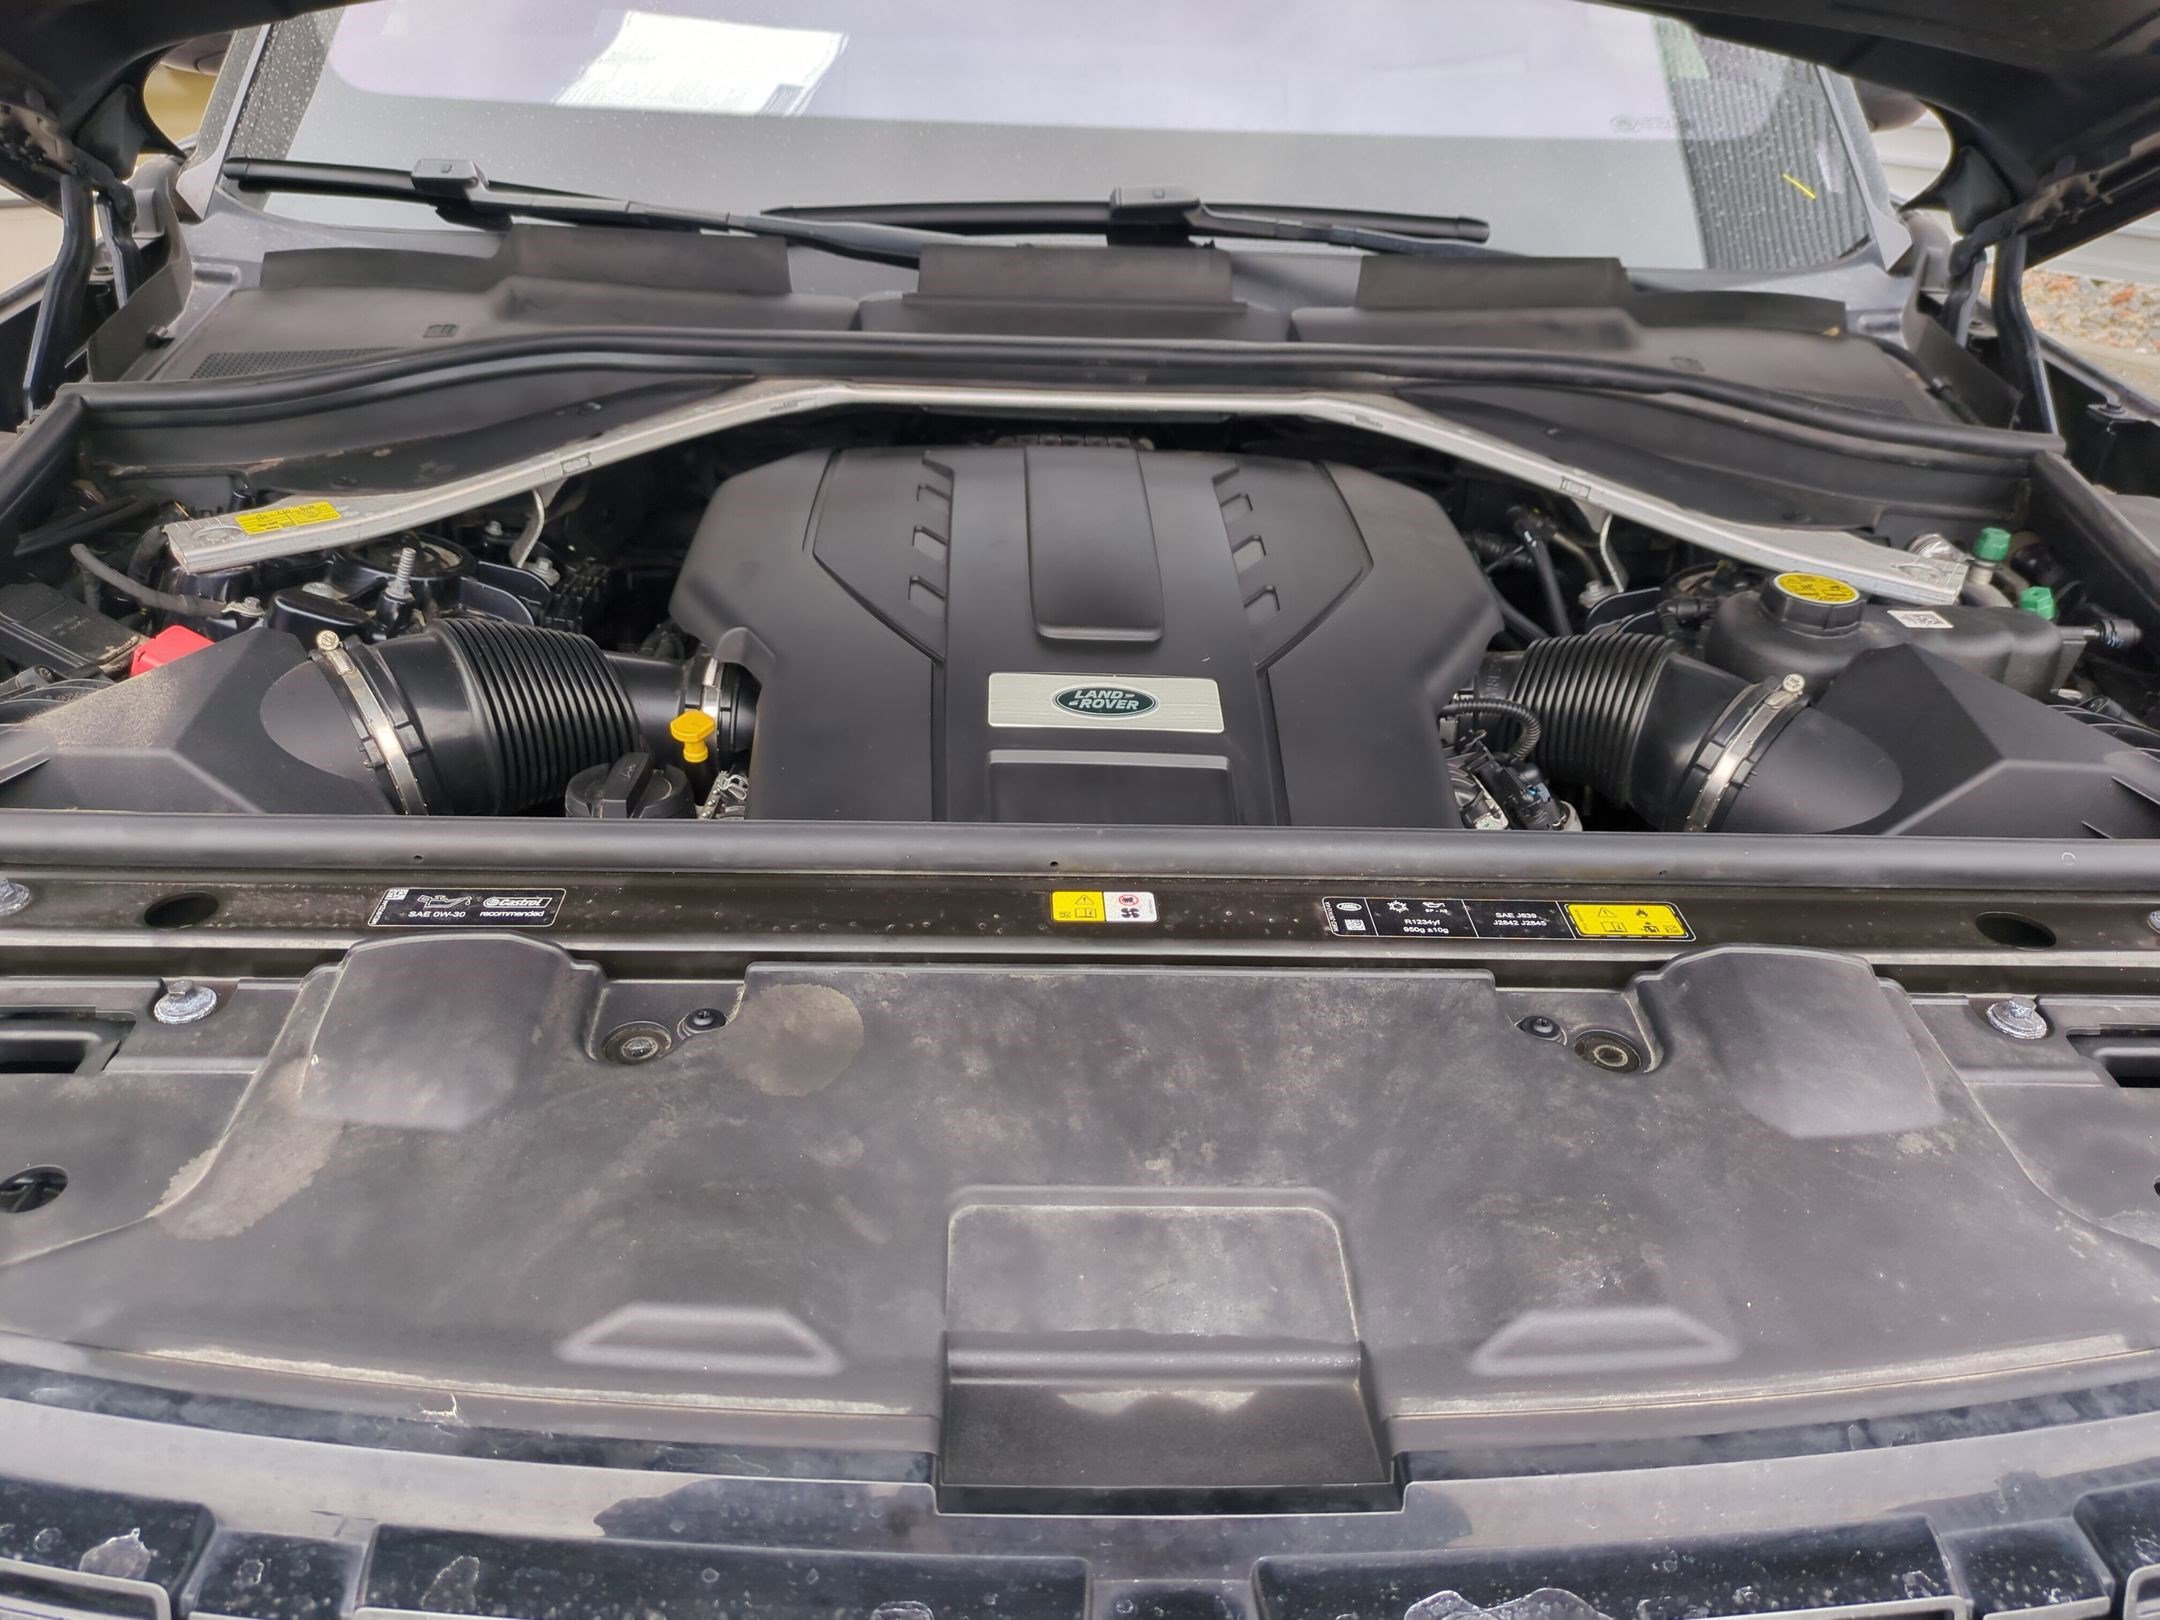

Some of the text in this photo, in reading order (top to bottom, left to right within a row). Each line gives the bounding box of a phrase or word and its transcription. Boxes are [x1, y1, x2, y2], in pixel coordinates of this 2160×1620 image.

[1074, 689, 1124, 699] LAND
[1079, 698, 1139, 710] ROVER
[1404, 918, 1440, 926] R1234yf
